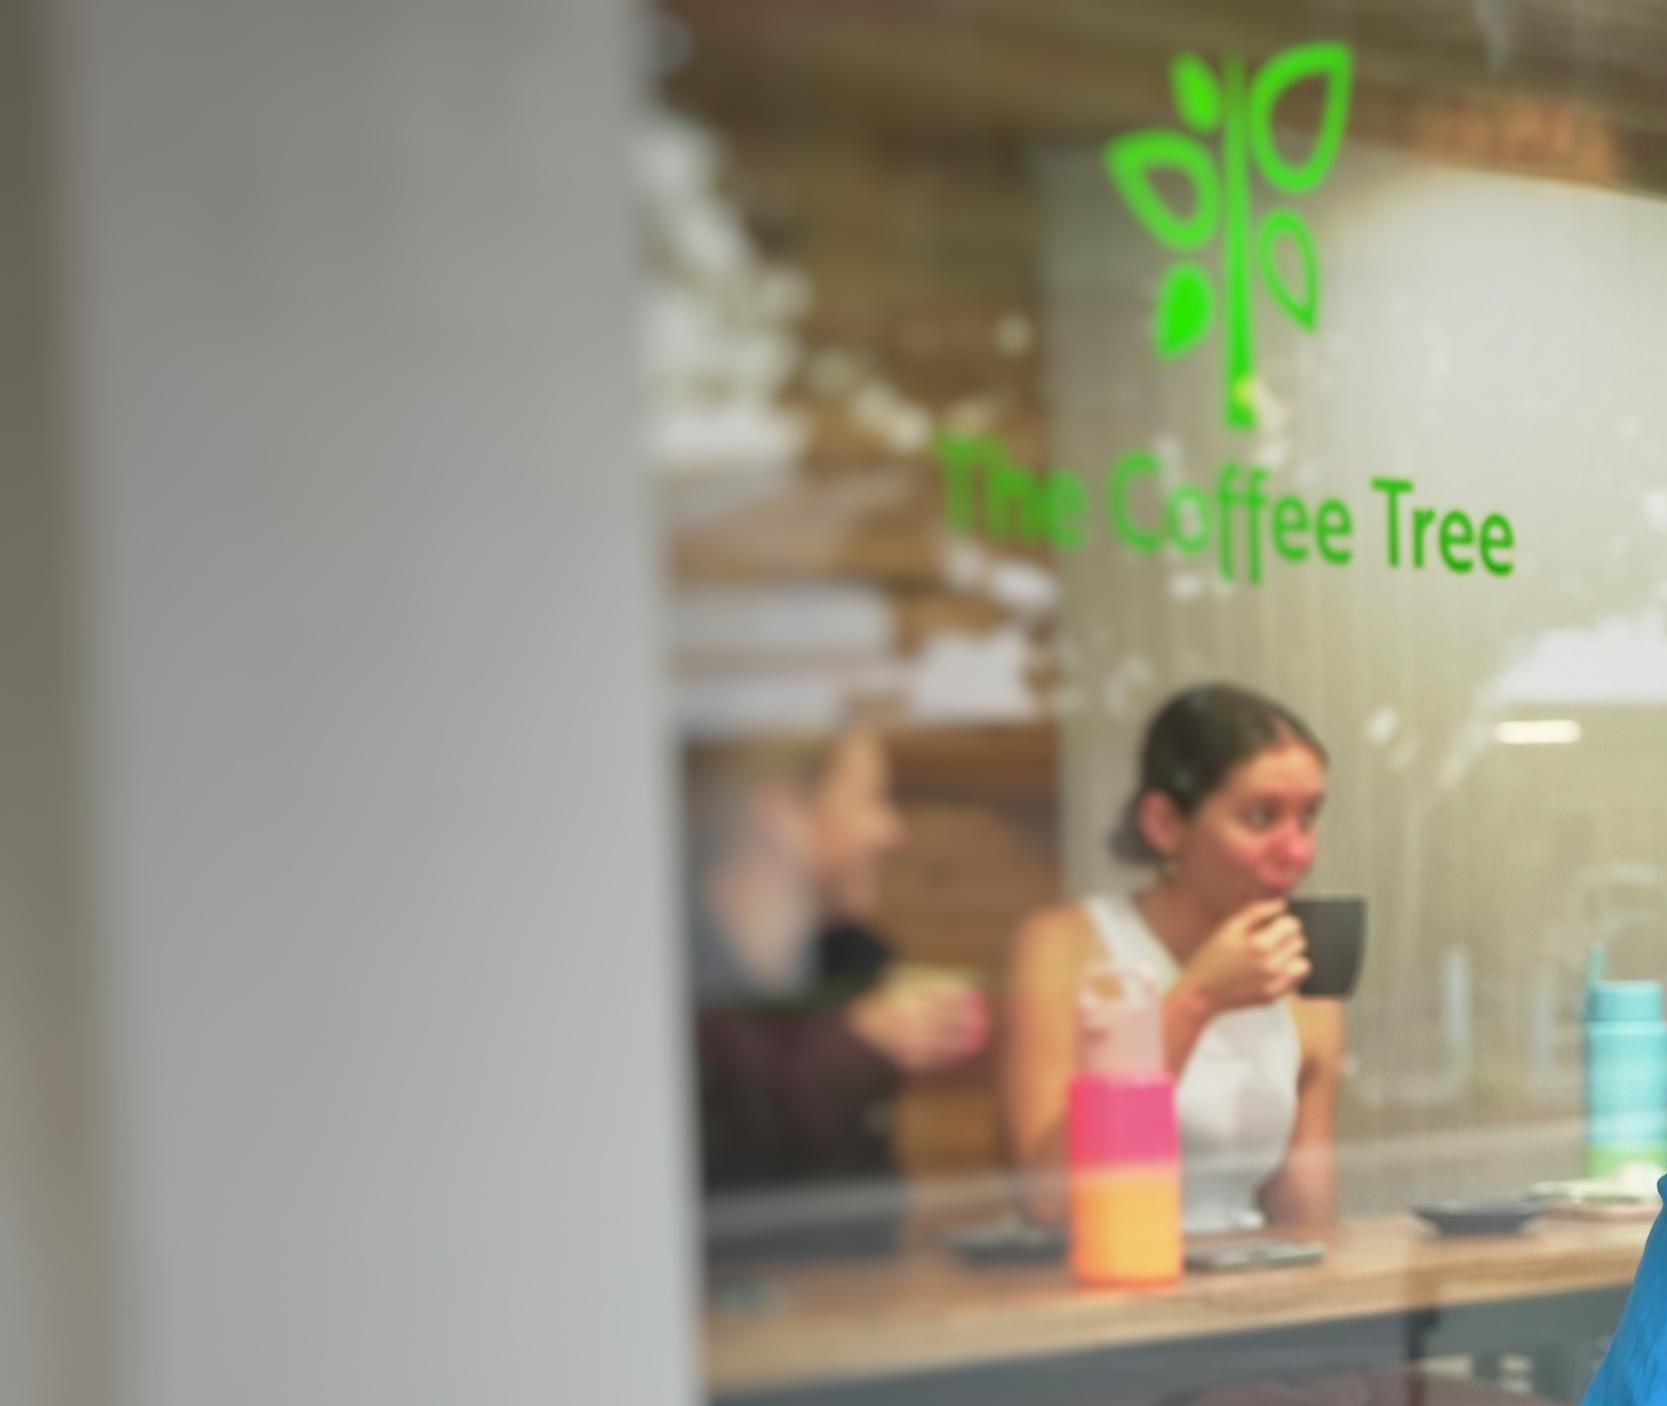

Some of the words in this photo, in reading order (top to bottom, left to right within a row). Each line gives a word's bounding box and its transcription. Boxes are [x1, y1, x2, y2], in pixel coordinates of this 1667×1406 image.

[938, 432, 1086, 548] The
[1110, 450, 1355, 586] Coffee
[1373, 476, 1515, 576] Tree
